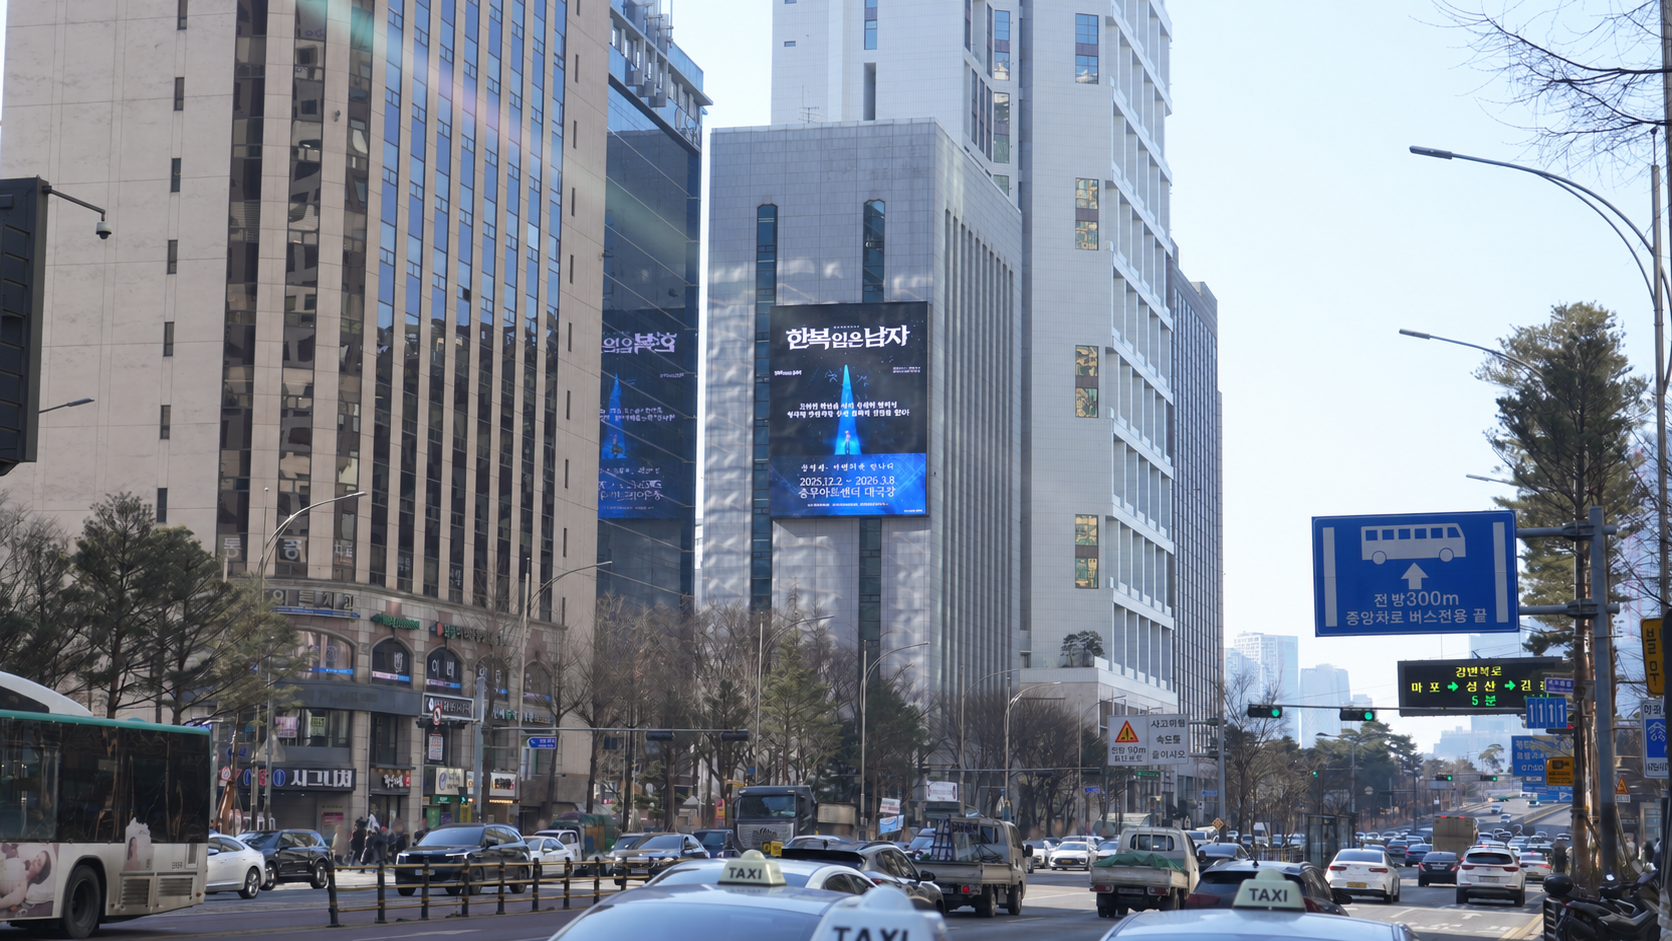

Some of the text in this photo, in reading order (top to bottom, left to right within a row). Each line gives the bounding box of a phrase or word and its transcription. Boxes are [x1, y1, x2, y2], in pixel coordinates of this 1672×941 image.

[1346, 607, 1488, 626] 중앙차로 버스전용 끝
[728, 867, 762, 880] TAXI
[1248, 887, 1289, 902] TAXI
